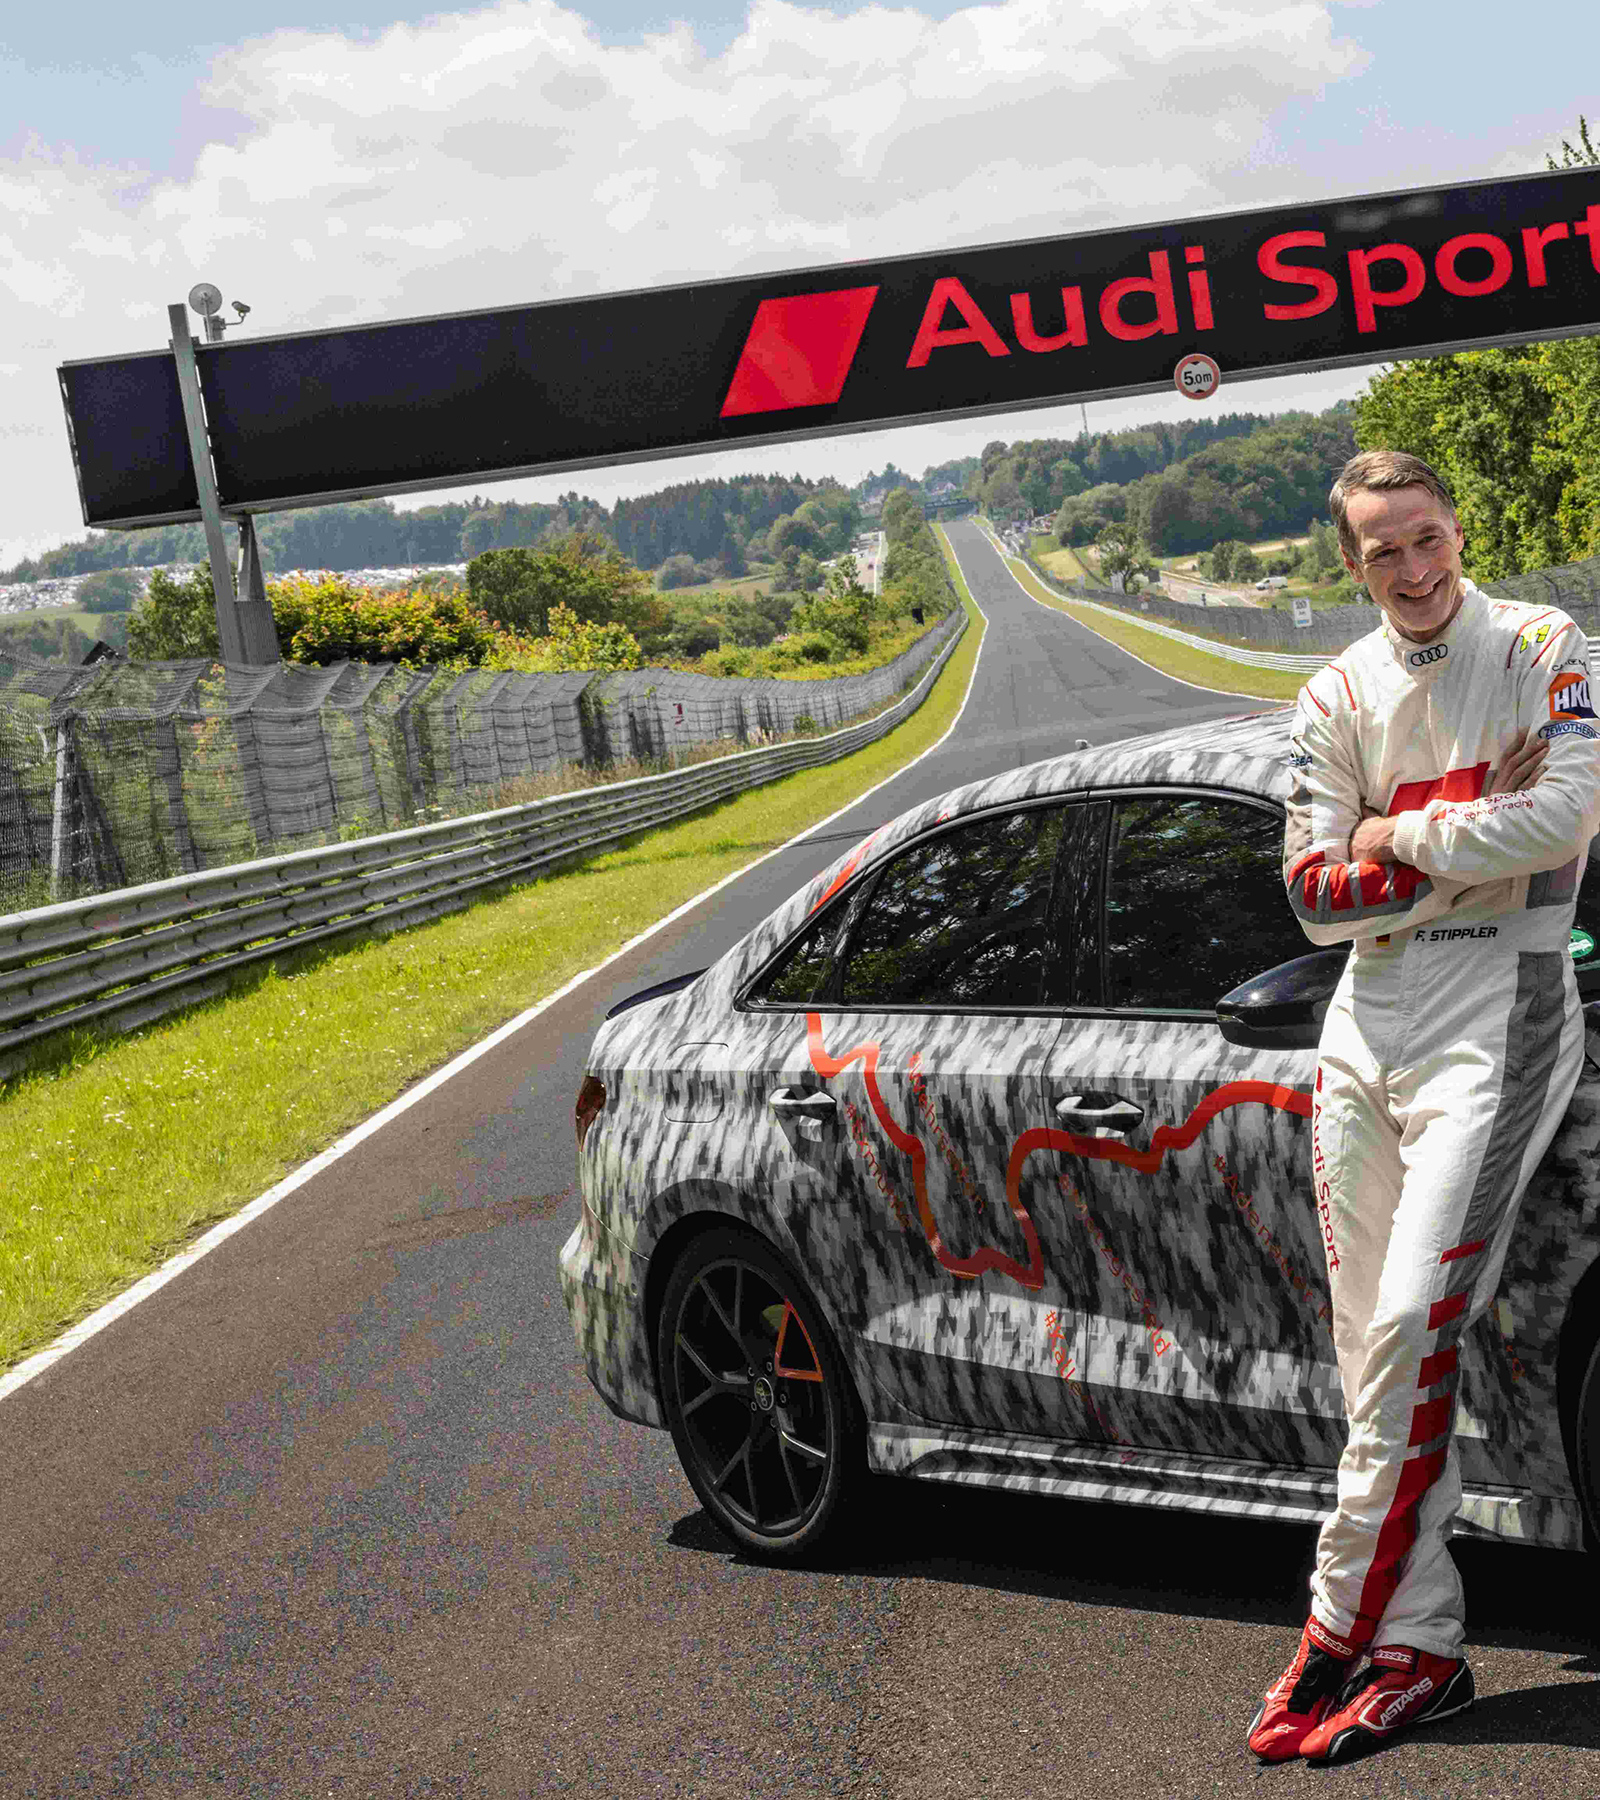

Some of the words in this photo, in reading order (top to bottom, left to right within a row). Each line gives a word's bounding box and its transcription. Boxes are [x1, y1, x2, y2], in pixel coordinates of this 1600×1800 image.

[905, 245, 1216, 369] Audi
[1502, 799, 1534, 810] racing
[1415, 930, 1426, 942] F.
[1430, 927, 1498, 941] STIPPLER
[1313, 1104, 1326, 1173] Audi
[1318, 1181, 1341, 1274] Sport
[1380, 1677, 1434, 1726] ASTARS
